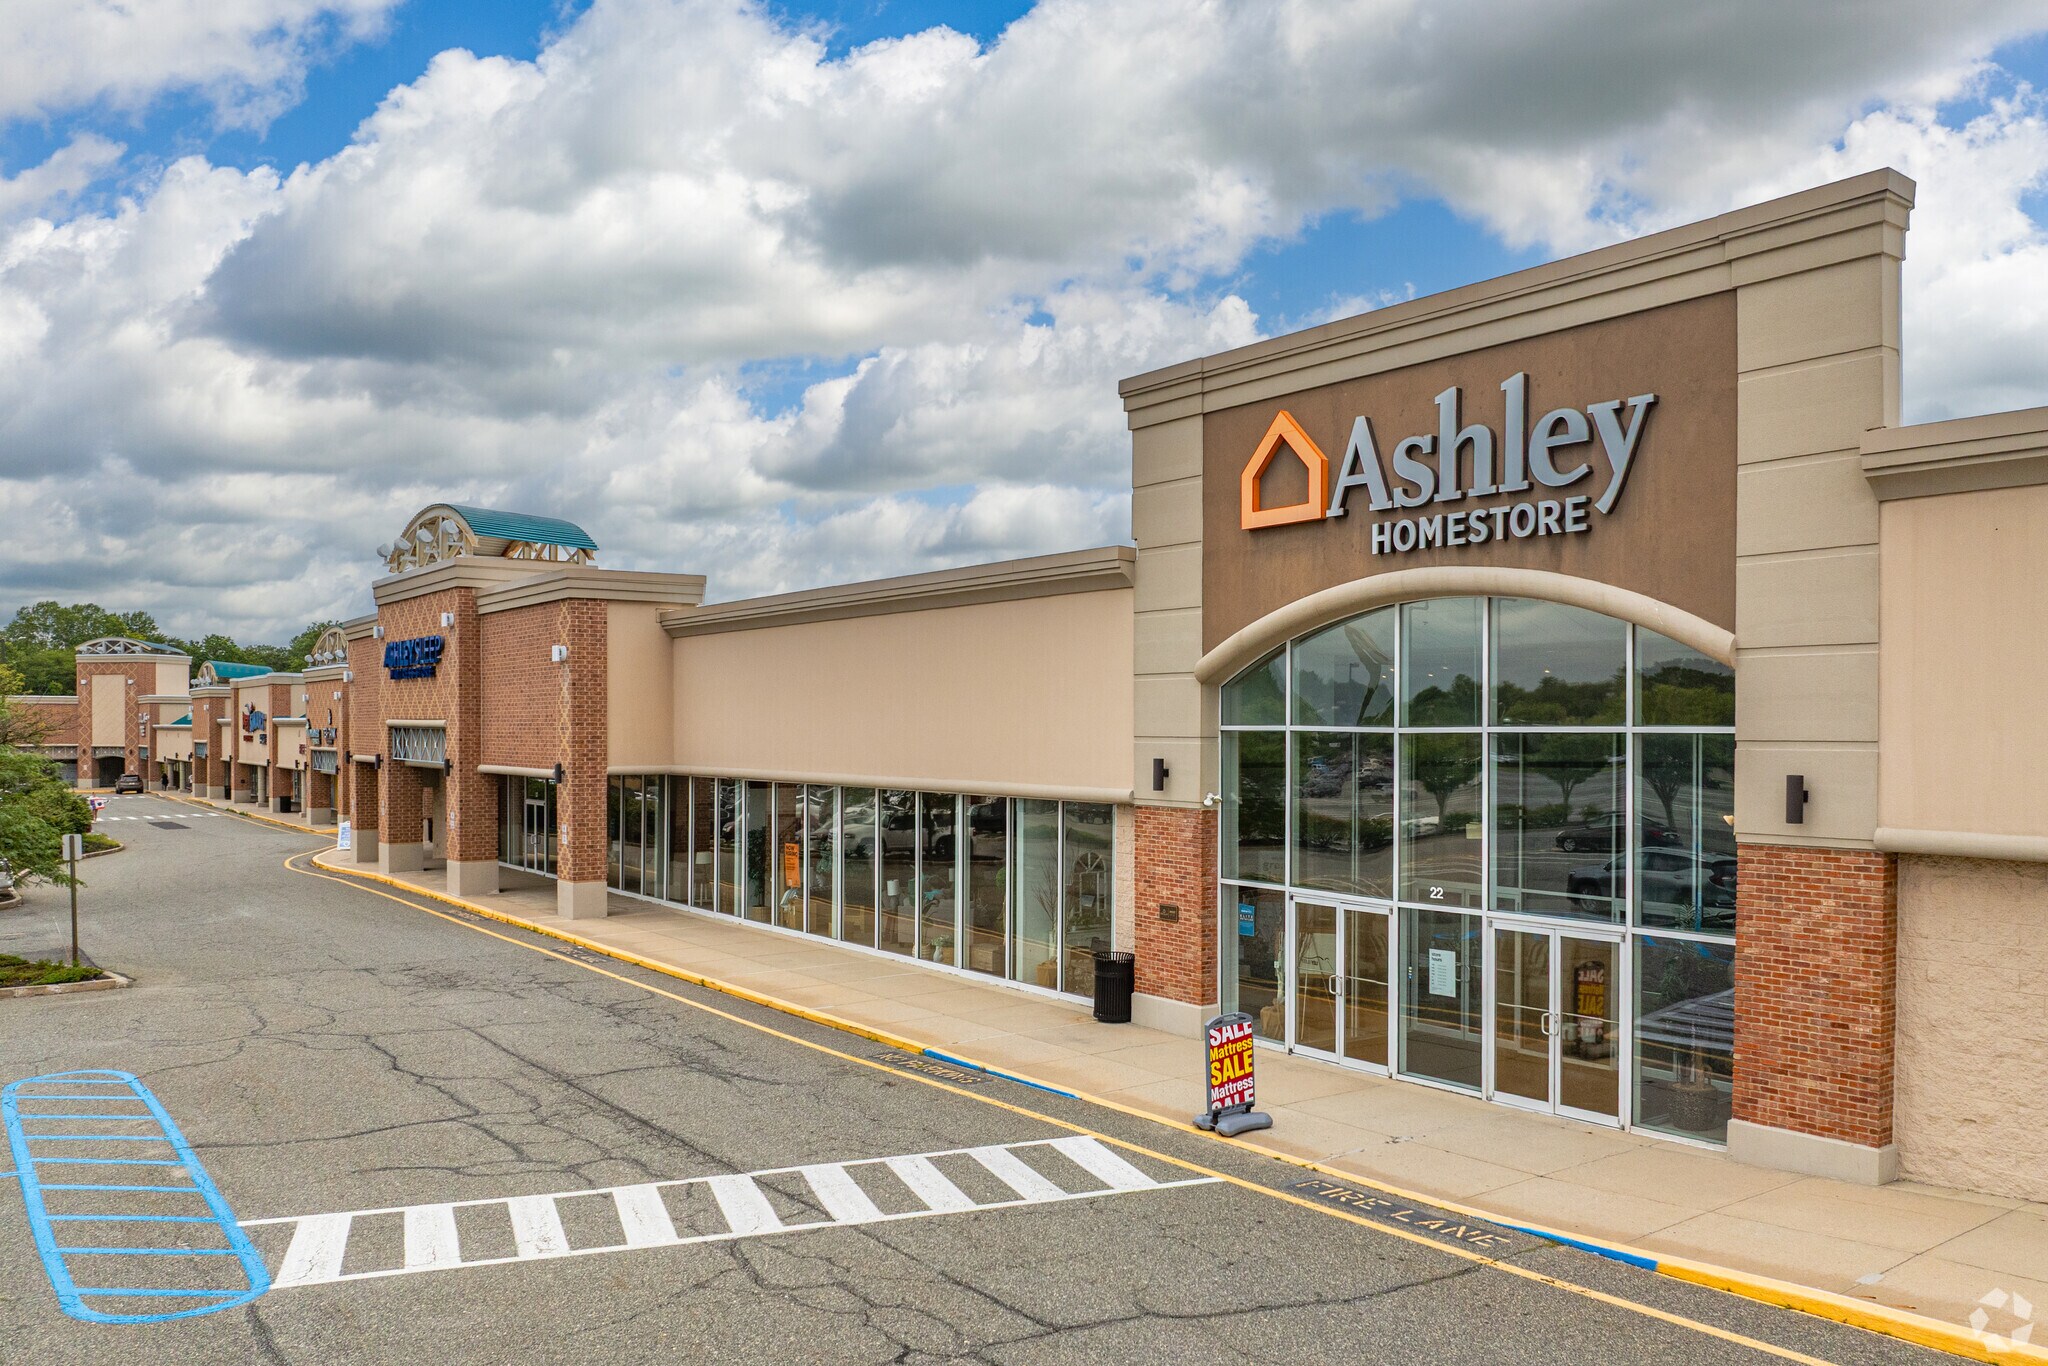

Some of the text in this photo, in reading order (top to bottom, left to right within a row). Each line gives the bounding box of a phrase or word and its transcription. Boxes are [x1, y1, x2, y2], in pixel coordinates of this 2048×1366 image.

[1327, 372, 1658, 517] Ashley
[1372, 495, 1591, 555] HOMESTORE
[1429, 886, 1444, 899] 22
[1209, 1021, 1252, 1047] SALE
[1210, 1037, 1253, 1062] Mattress
[1210, 1049, 1253, 1086] SALE
[1211, 1076, 1254, 1102] Mattress
[1296, 1180, 1511, 1248] FIRE LANE
